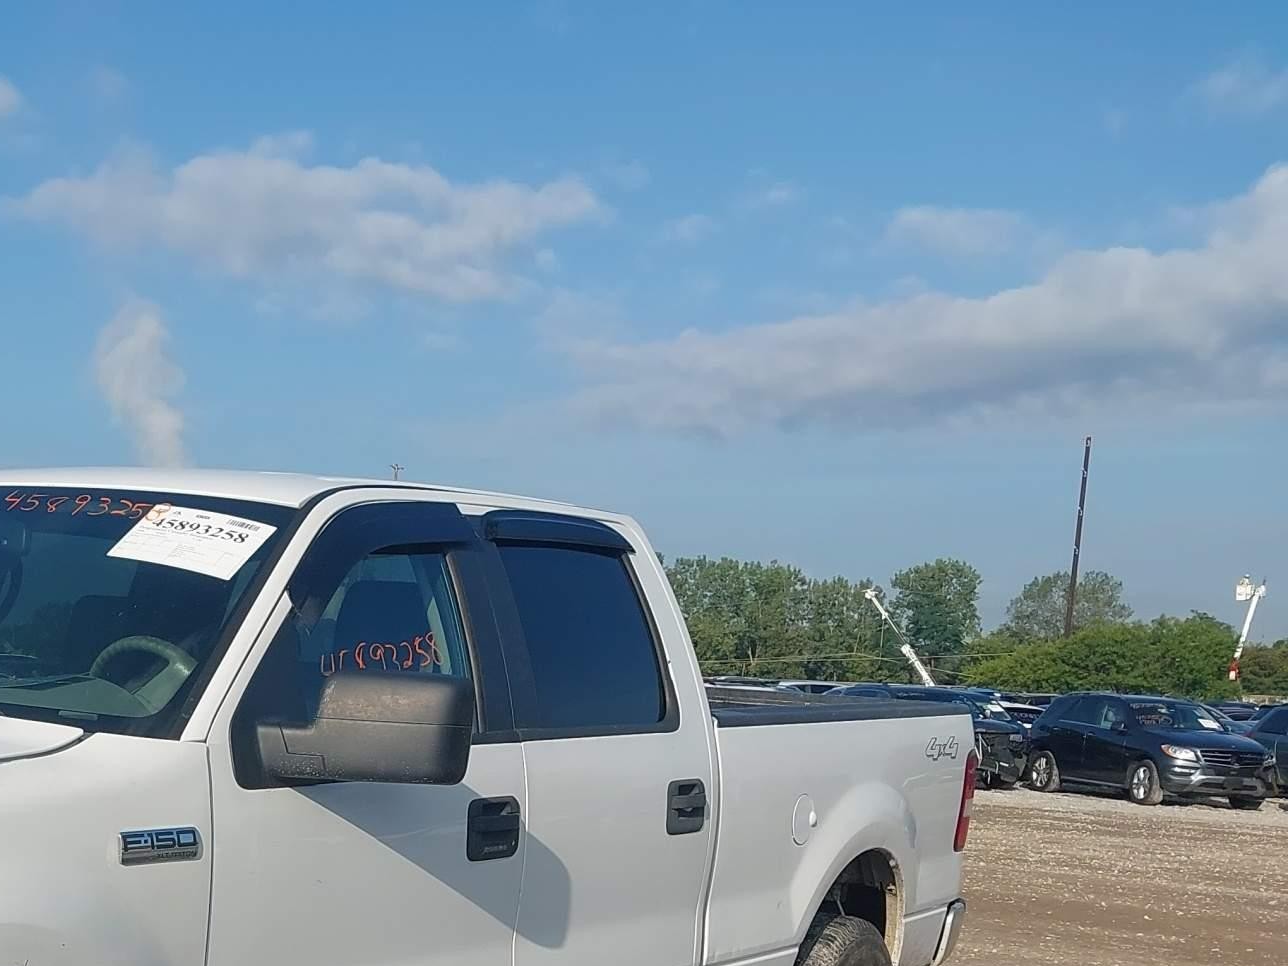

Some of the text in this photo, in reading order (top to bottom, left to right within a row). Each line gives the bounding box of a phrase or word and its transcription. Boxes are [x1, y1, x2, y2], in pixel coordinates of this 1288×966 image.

[4, 488, 172, 521] 45893258
[152, 517, 250, 544] 45893258
[925, 735, 959, 761] 4x4
